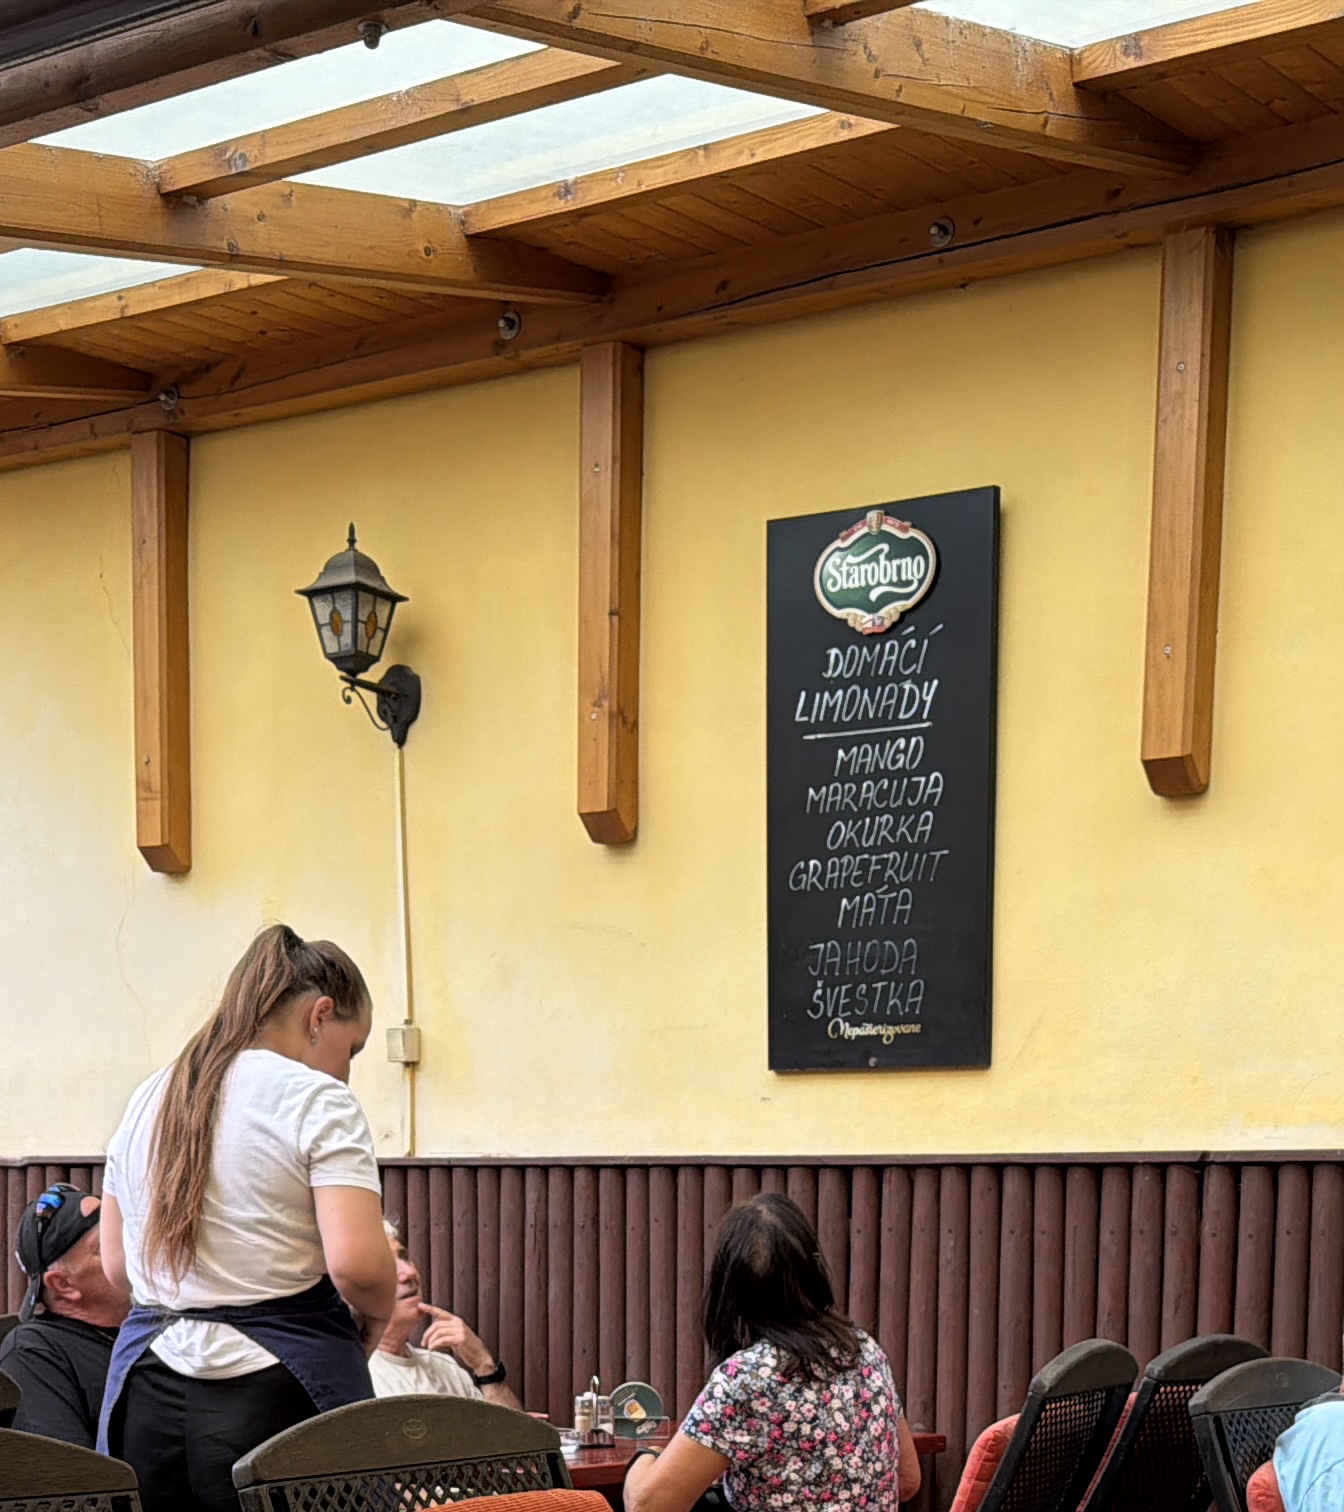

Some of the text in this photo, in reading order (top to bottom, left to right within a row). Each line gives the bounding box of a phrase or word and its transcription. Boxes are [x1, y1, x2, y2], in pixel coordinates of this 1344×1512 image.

[826, 543, 925, 602] Starobrno
[833, 735, 925, 777] MANGO
[805, 771, 944, 814] MARACUJA
[826, 810, 934, 850] OKURKA
[788, 849, 950, 892] GRAPEFRUIT
[837, 884, 913, 929] MÁTA
[807, 938, 918, 977] JAHODA
[806, 979, 926, 1019] ŠVESTKA
